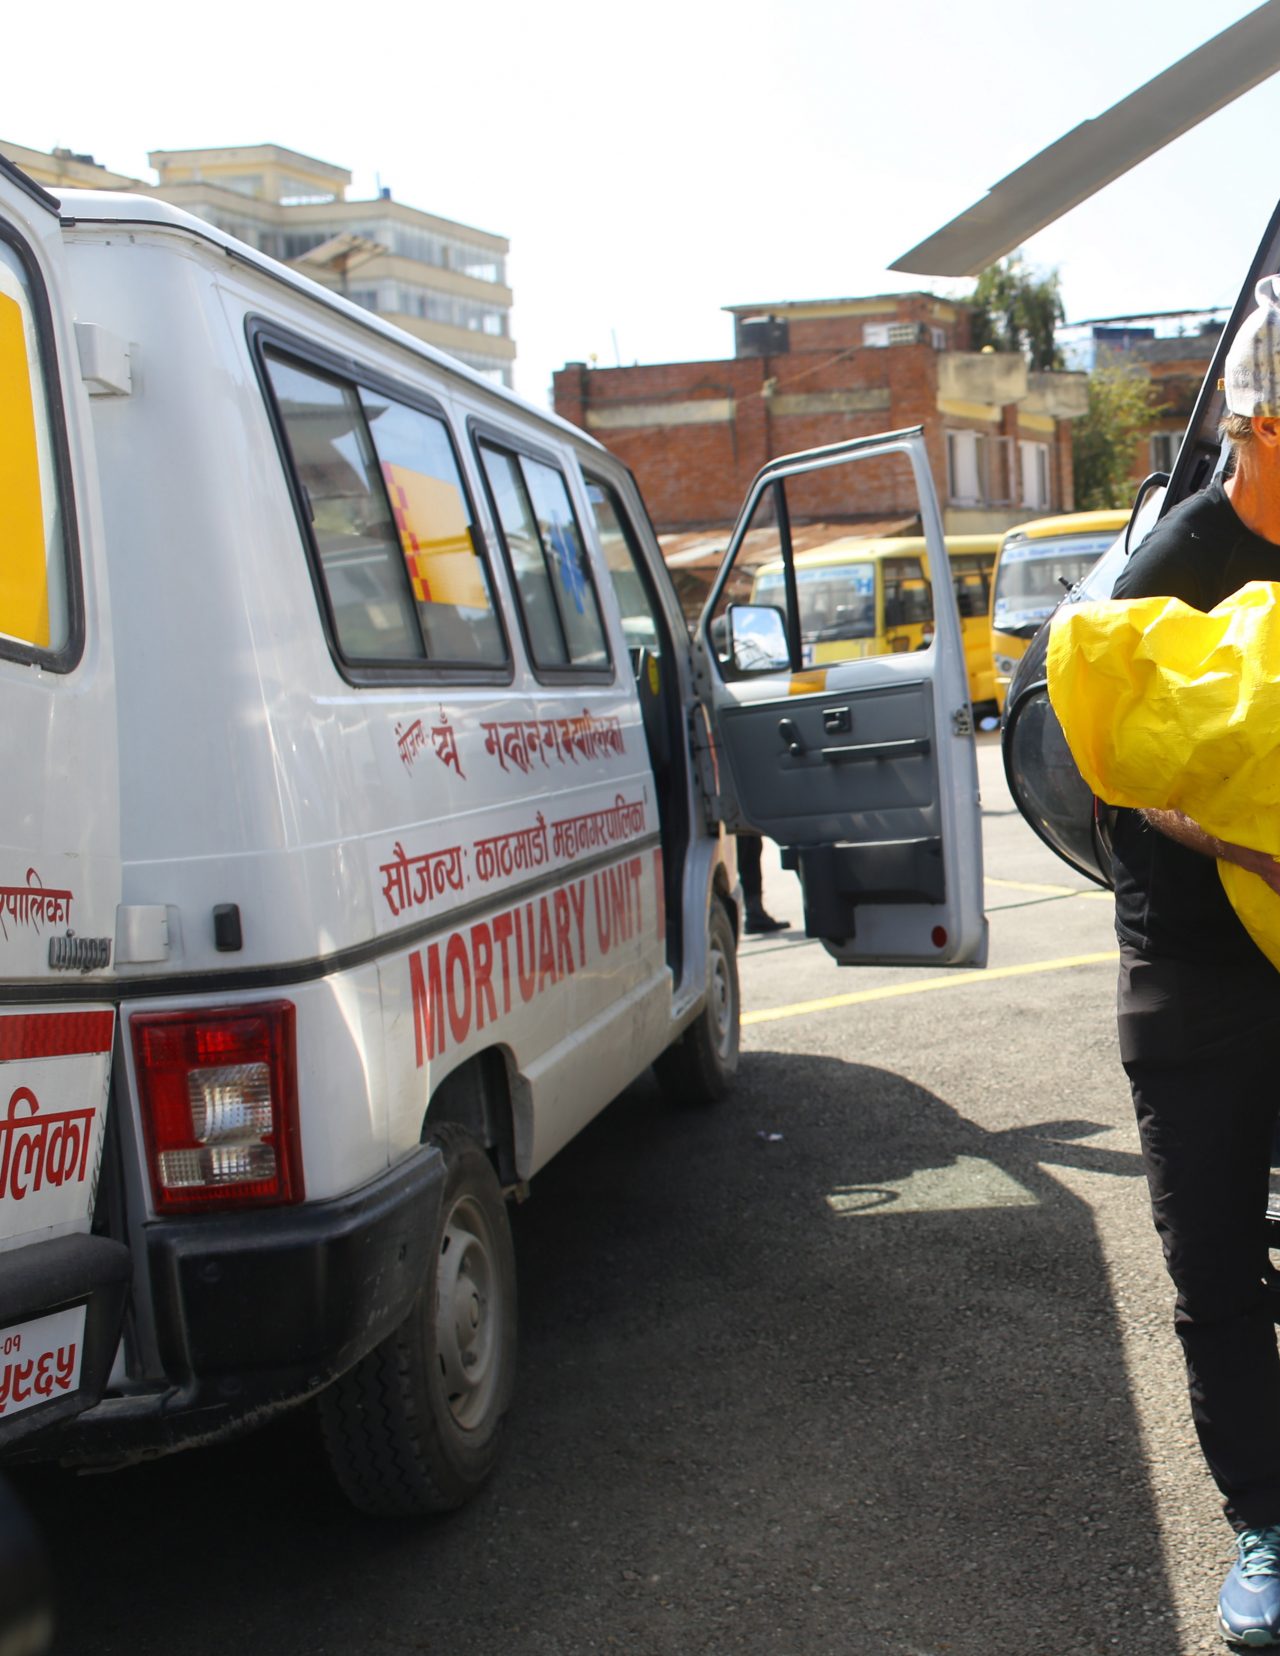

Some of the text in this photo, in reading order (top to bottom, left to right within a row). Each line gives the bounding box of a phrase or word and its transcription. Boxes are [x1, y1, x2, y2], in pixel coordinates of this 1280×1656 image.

[379, 841, 469, 916] सौजन्य:
[409, 856, 643, 1069] MORTUARY UNIT
[0, 1087, 96, 1201] लिका
